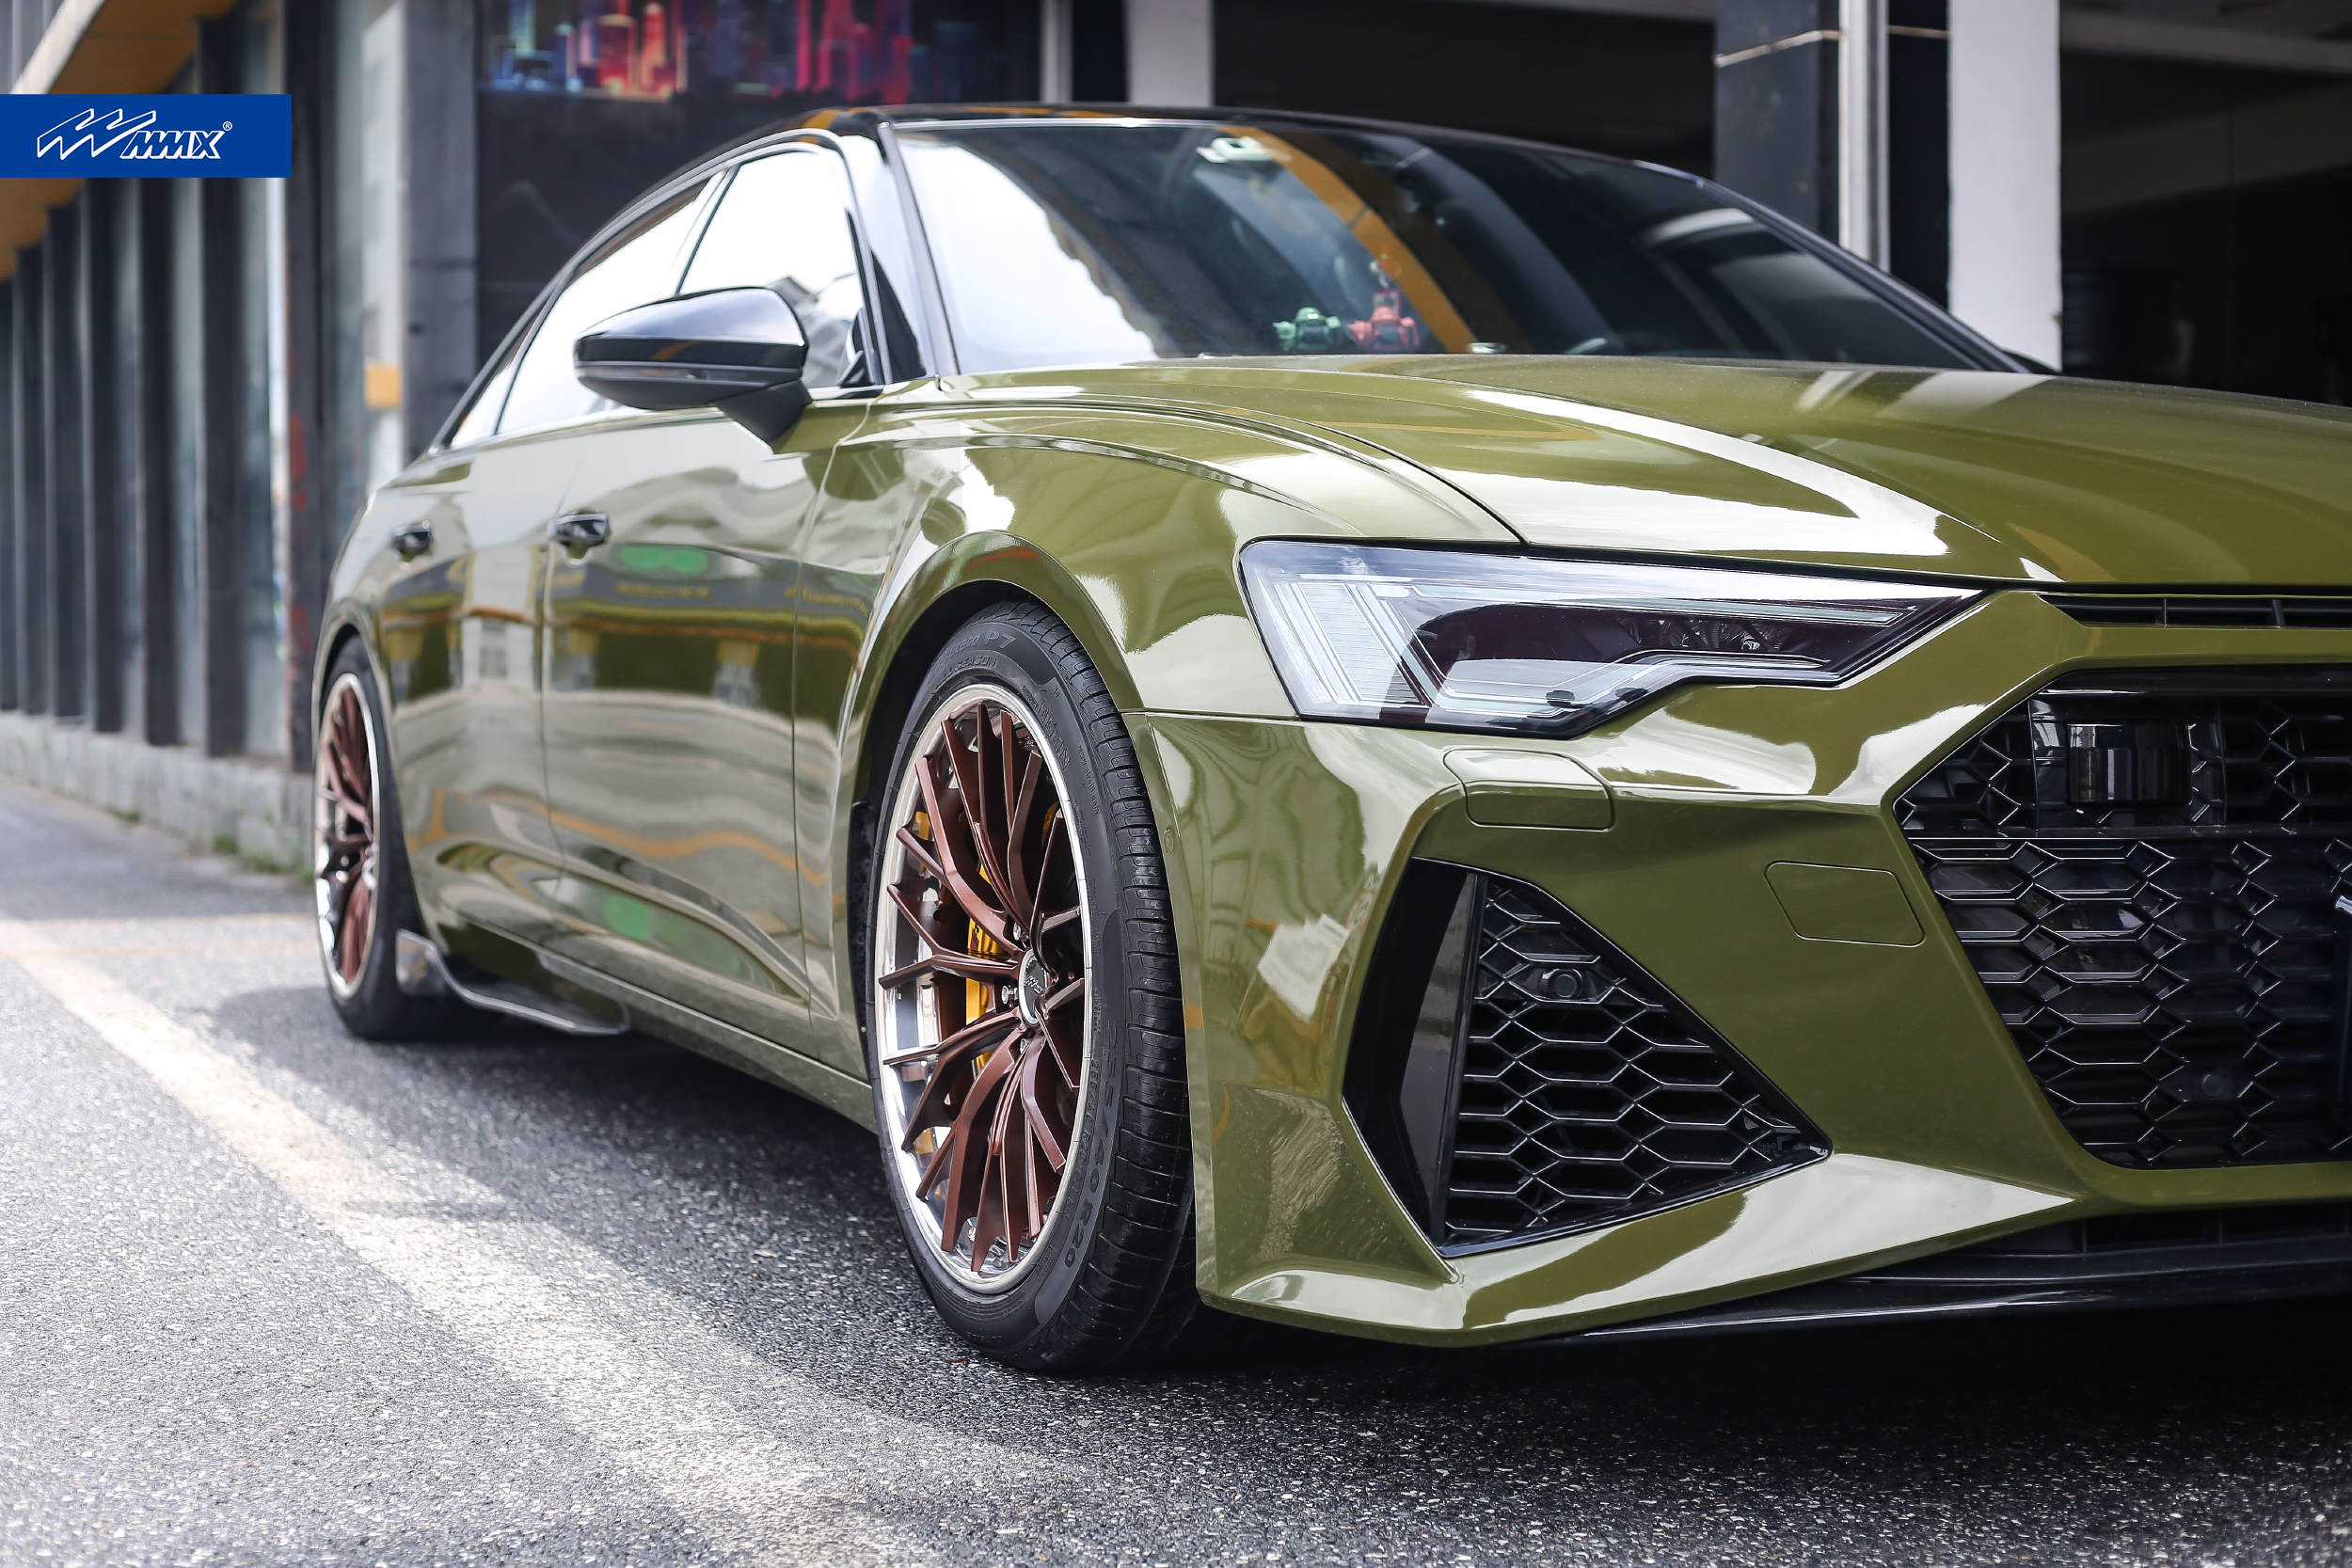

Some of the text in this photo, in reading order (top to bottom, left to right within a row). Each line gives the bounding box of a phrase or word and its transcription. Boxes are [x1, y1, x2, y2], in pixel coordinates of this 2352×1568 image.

[984, 630, 1017, 649] P7
[954, 654, 999, 673] SEASON
[1089, 1019, 1118, 1194] 255/40
[1064, 1197, 1094, 1268] R20
